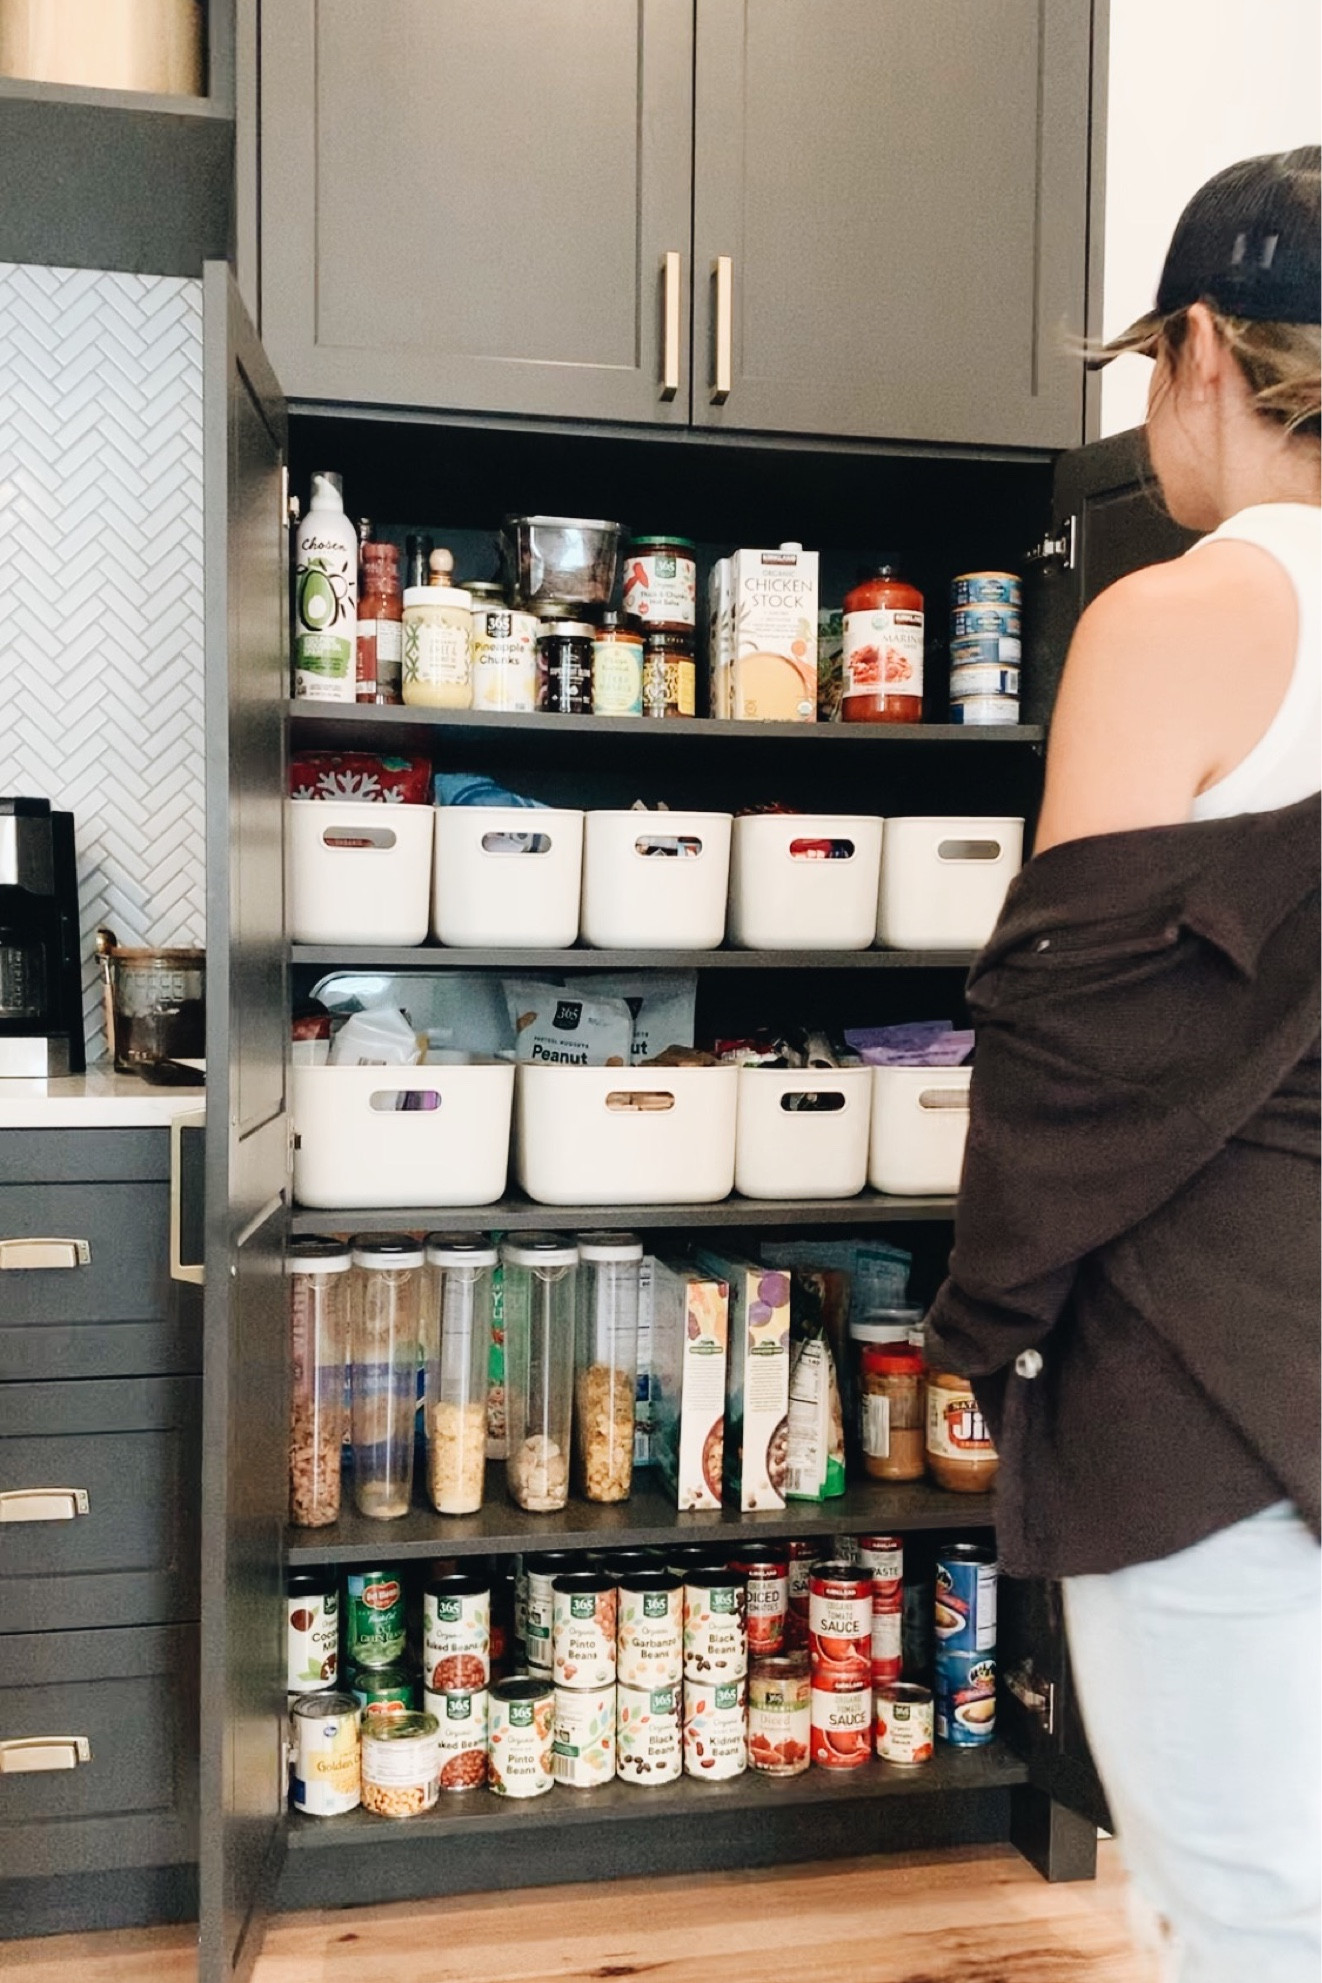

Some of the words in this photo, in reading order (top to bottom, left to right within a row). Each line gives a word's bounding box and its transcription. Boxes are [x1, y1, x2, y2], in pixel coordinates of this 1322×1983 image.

[301, 537, 347, 551] Chosen
[744, 577, 813, 592] CHICKEN
[752, 593, 804, 609] STOCK
[487, 617, 510, 631] 365
[475, 642, 525, 654] Pineapple
[480, 655, 520, 666] Chunks
[557, 1007, 578, 1020] 365
[532, 1044, 588, 1065] Peanut
[713, 1594, 733, 1605] 365
[746, 1592, 779, 1603] DICED
[438, 1602, 460, 1614] 365
[572, 1599, 593, 1610] 365
[645, 1599, 666, 1610] 365
[821, 1619, 859, 1632] SAUCE
[709, 1633, 735, 1643] Black
[570, 1639, 595, 1649] Pinto
[707, 1644, 736, 1655] Beans
[568, 1650, 597, 1660] Beans
[641, 1649, 669, 1659] Beans
[652, 1695, 672, 1706] 365
[717, 1690, 737, 1700] 365
[449, 1700, 470, 1712] 365
[510, 1707, 532, 1720] 365
[829, 1713, 866, 1726] SAUCE
[649, 1734, 674, 1745] Black
[648, 1745, 675, 1756] Beans
[712, 1747, 739, 1757] Beans
[508, 1754, 535, 1764] Pinto
[317, 1759, 354, 1773] Golden
[506, 1764, 536, 1775] Beans
